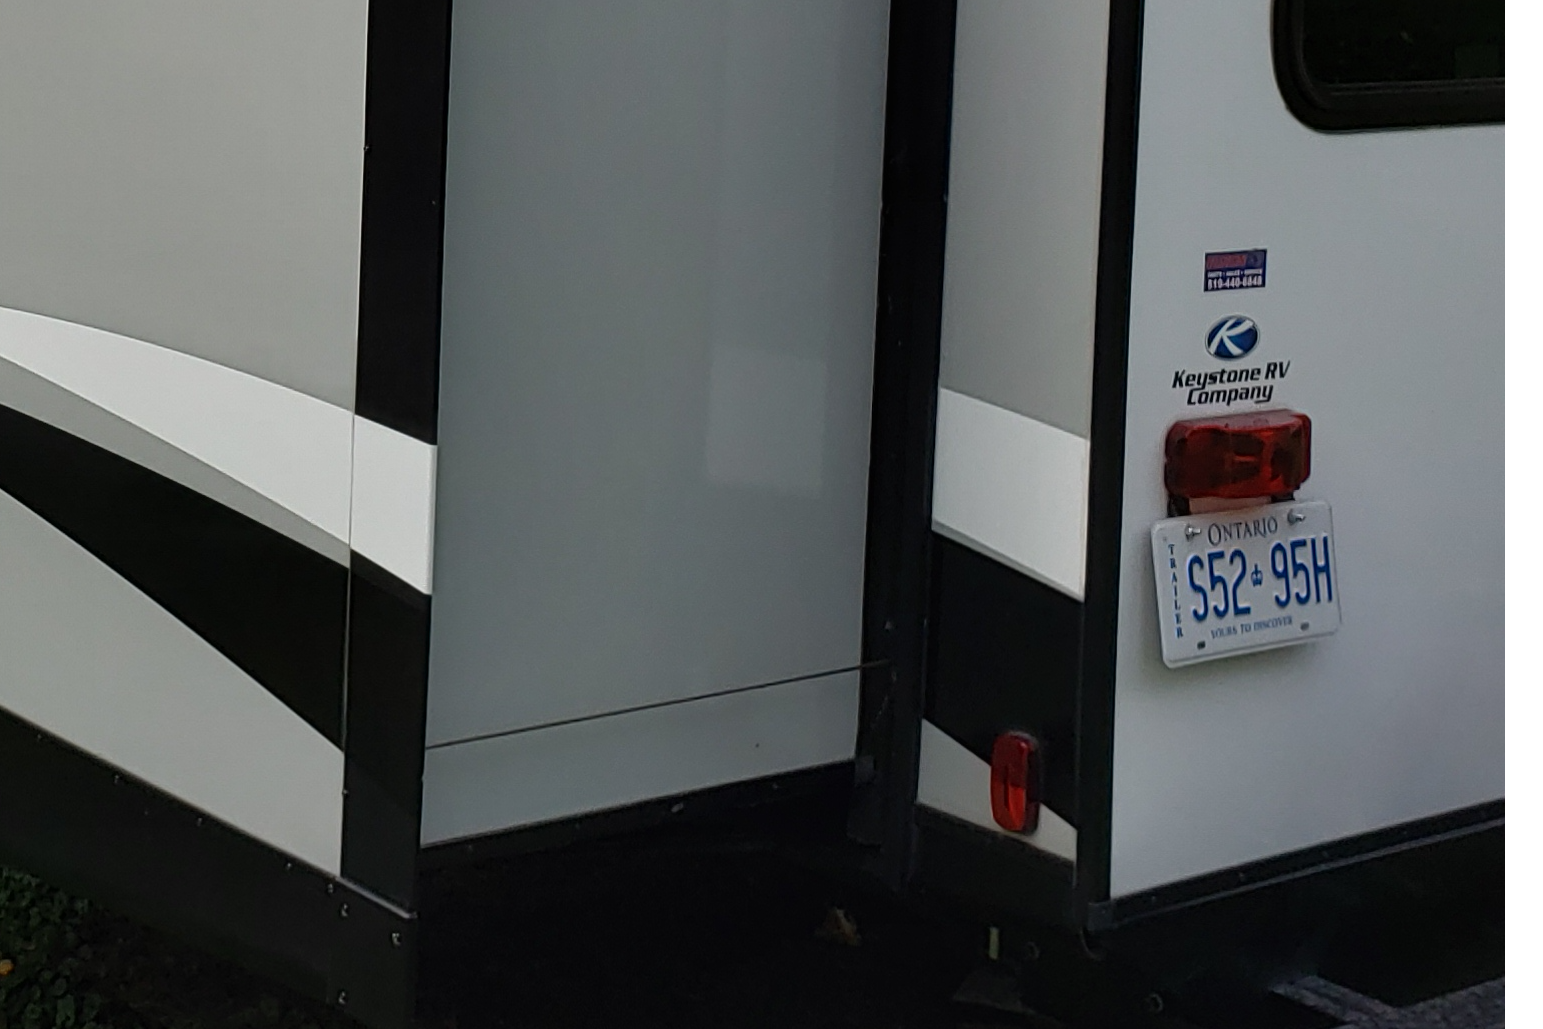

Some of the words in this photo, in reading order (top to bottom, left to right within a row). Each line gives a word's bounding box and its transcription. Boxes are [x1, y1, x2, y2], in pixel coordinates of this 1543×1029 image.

[1172, 366, 1261, 390] Keystone
[1264, 360, 1291, 380] RV
[1187, 384, 1274, 406] Company
[1208, 516, 1278, 546] ONTARIO
[1187, 548, 1251, 621] S52
[1270, 535, 1333, 609] 95H
[1211, 625, 1238, 639] YOURS
[1240, 623, 1252, 634] TO
[1253, 615, 1293, 631] DISCOVER
